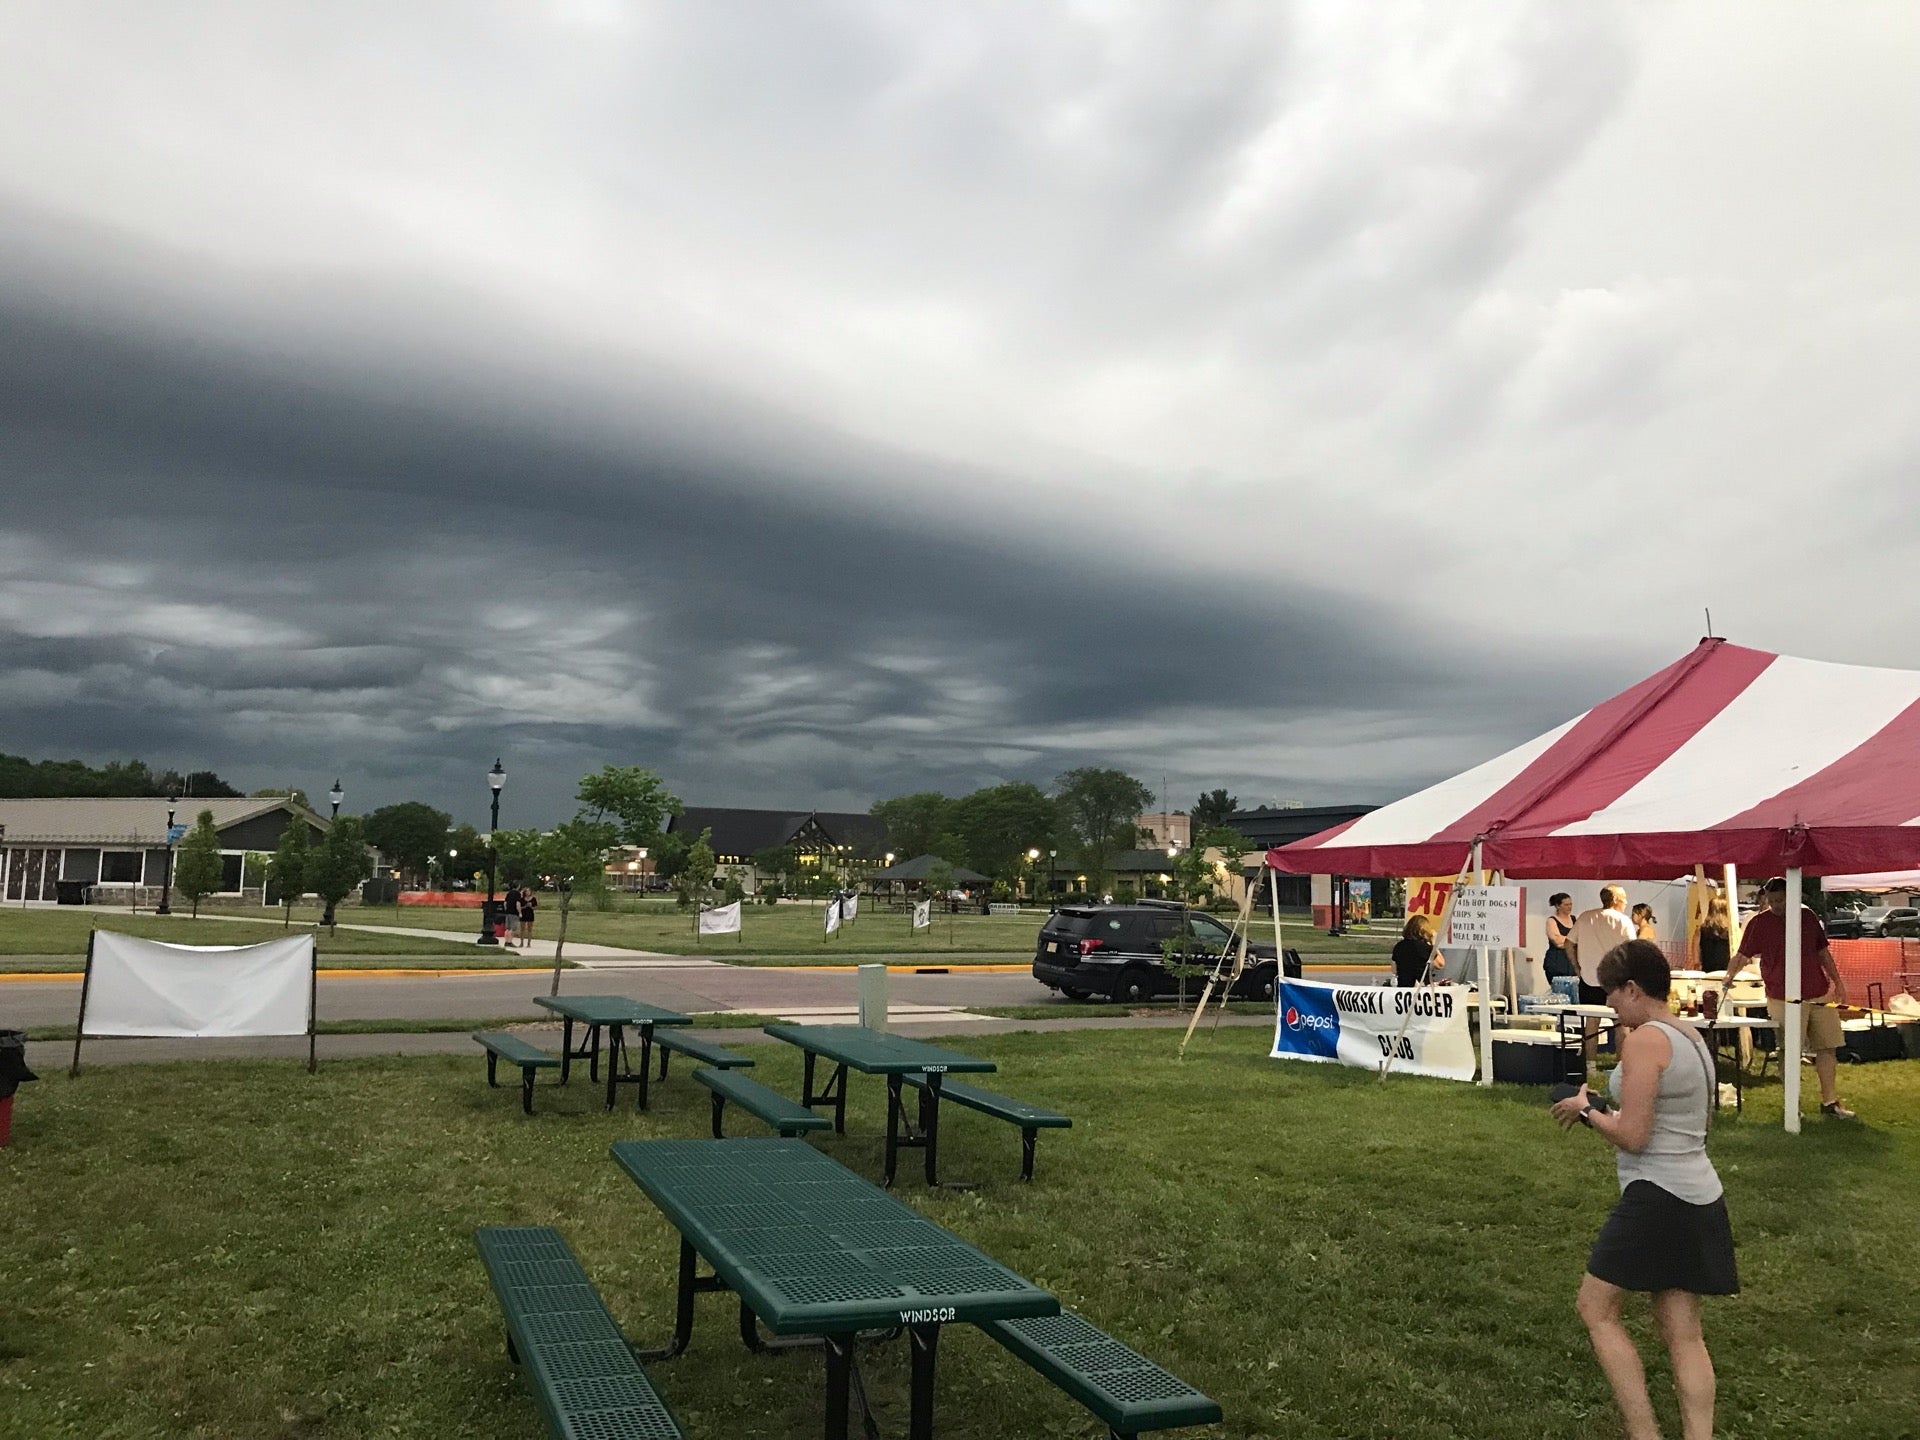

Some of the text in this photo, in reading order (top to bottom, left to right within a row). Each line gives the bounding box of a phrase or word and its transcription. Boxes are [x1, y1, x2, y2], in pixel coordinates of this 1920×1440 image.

[1489, 899, 1508, 908] DOGS
[1453, 922, 1475, 930] WATER
[1395, 991, 1453, 1018] SOCCER
[1300, 1014, 1333, 1031] pepsi
[1377, 1034, 1414, 1060] CLUB
[921, 1065, 948, 1073] WINDSOR
[899, 1307, 955, 1323] WINDSOR
